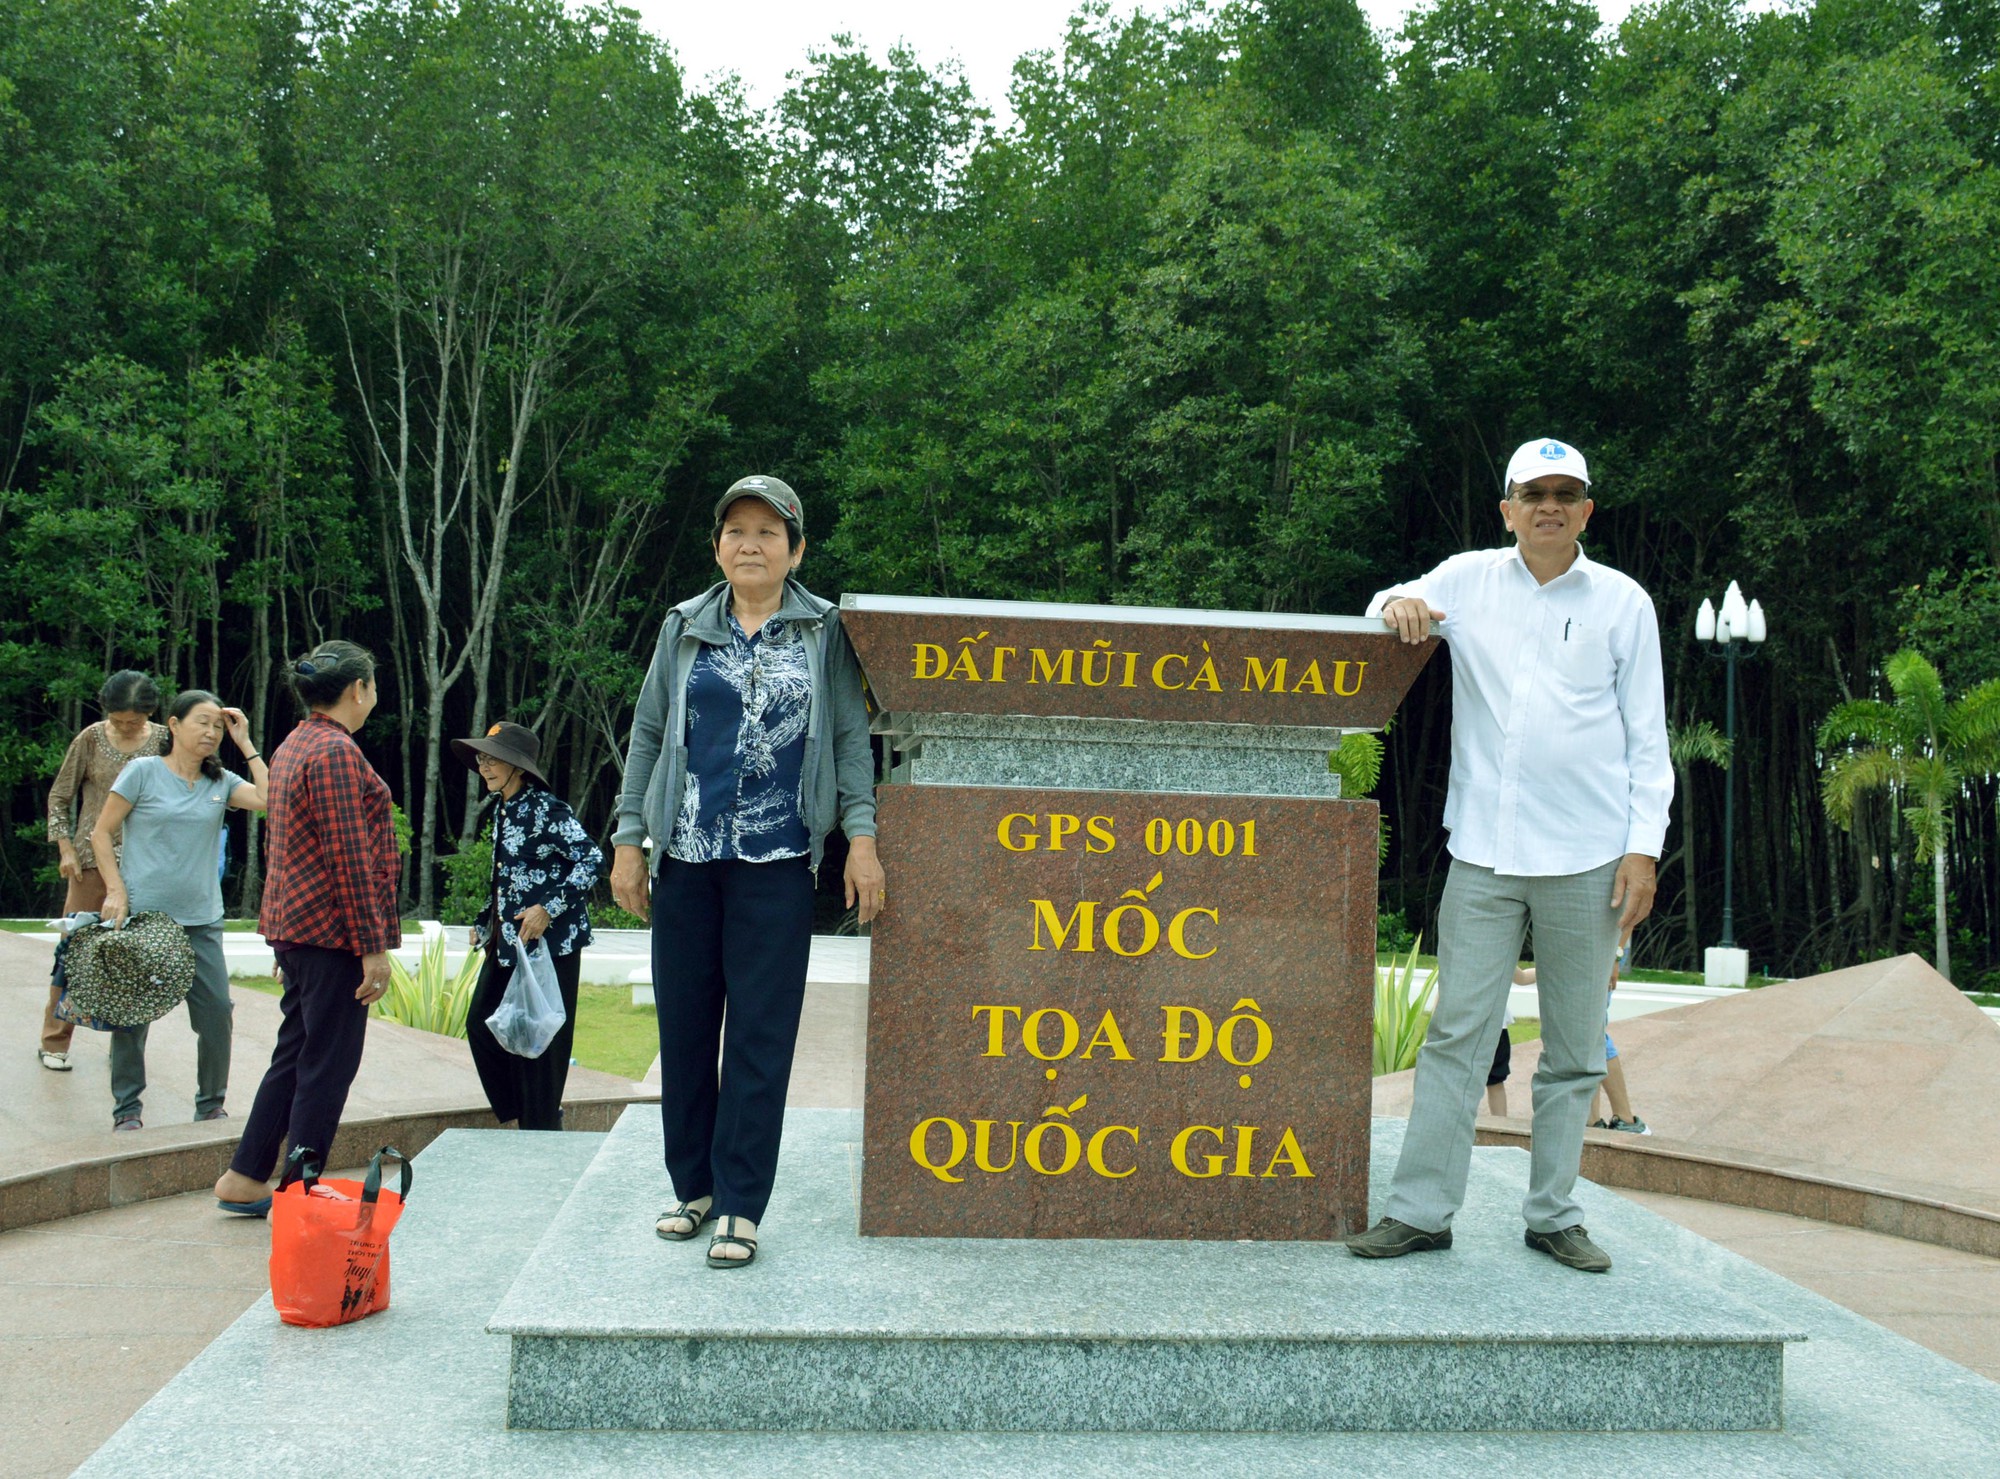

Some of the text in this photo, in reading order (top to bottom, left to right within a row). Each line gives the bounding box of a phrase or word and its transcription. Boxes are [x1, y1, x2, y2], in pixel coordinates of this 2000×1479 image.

[911, 631, 1368, 697] ĐẤT MŨI CÀ MAU
[996, 812, 1261, 858] GPS 0001
[1027, 871, 1220, 961] MỐC
[972, 997, 1274, 1090] TỌA ĐỘ
[908, 1093, 1315, 1184] QUỐC GIA
